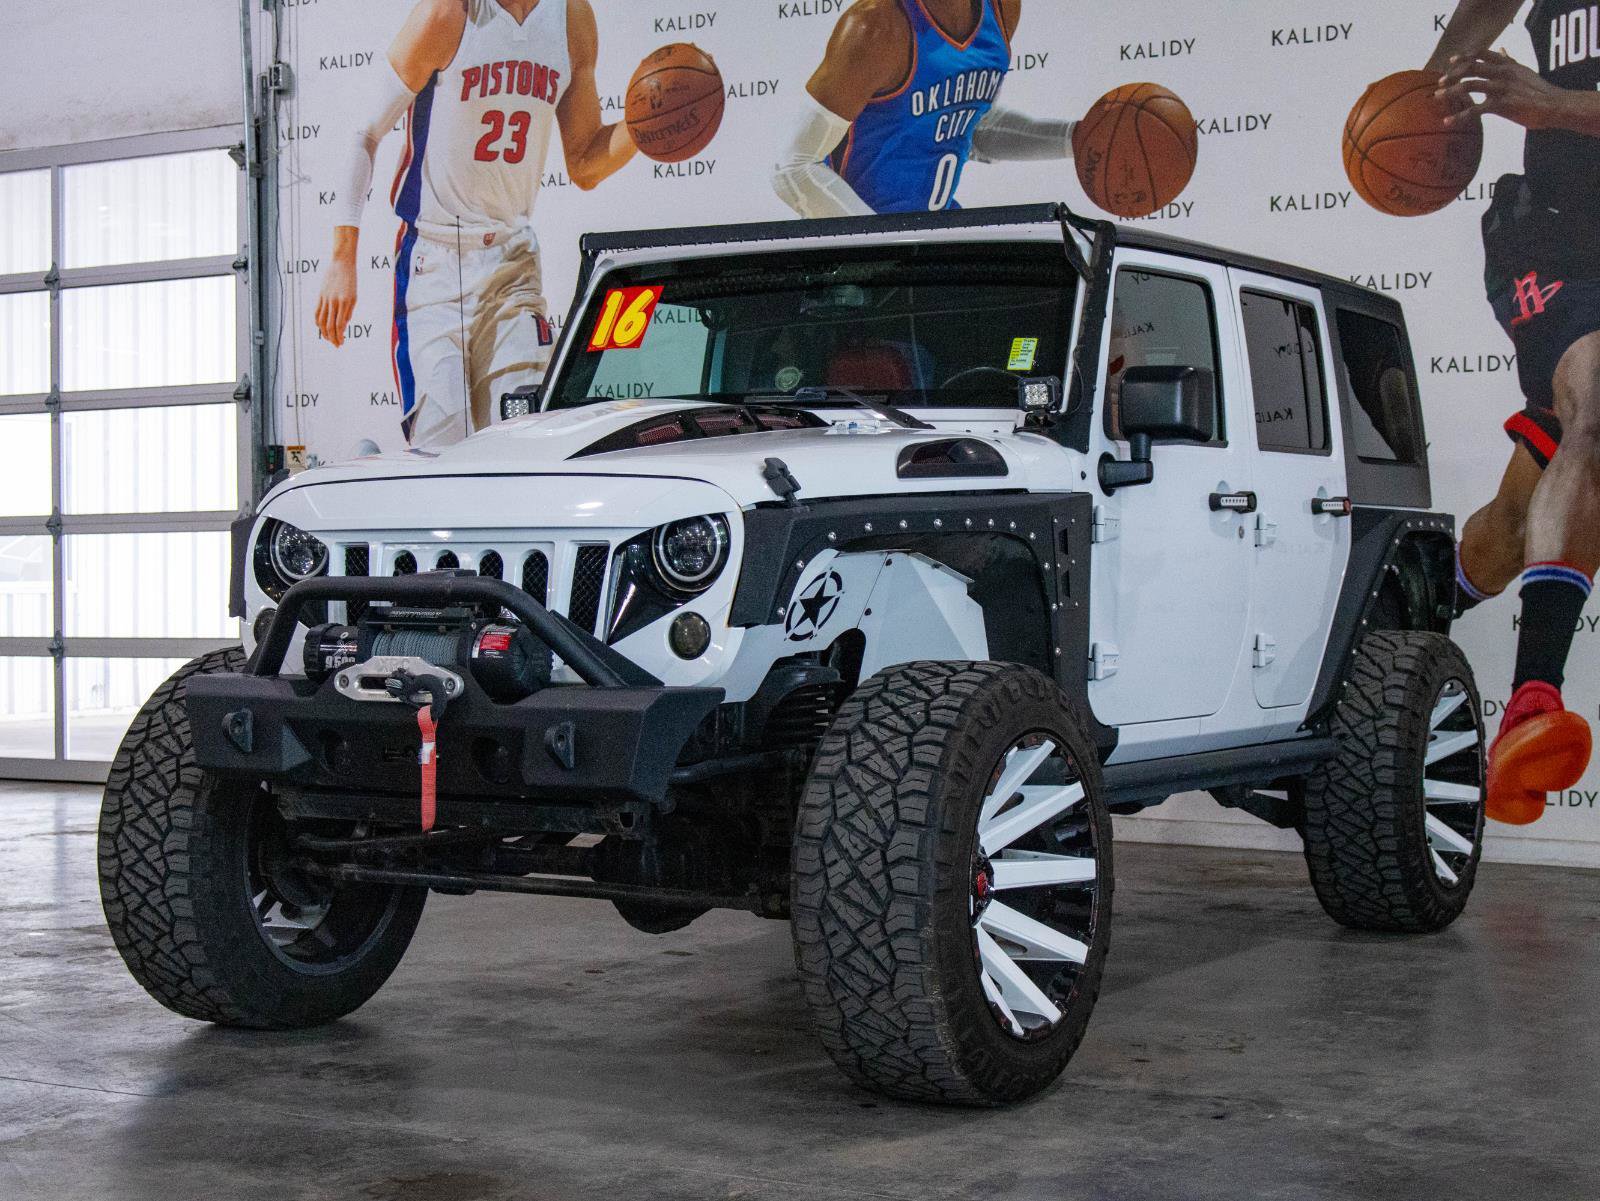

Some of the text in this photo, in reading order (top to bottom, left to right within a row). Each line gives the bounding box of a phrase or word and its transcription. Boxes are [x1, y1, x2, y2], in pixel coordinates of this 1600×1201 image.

[779, 0, 843, 19] KALIDY
[654, 12, 717, 32] KALIDY
[1272, 23, 1353, 46] KALIDY
[1120, 38, 1196, 60] KALIDY
[320, 52, 374, 70] KALIDY
[461, 60, 560, 105] PISTONS
[727, 80, 779, 98] ALIDY
[912, 70, 1001, 116] OKLAHOM
[935, 109, 976, 142] CITY
[1195, 114, 1272, 135] KALIDY
[474, 109, 531, 164] 23
[654, 160, 716, 179] KALIDY
[1270, 192, 1351, 213] KALIDY
[1351, 272, 1433, 291] KALIDY
[591, 288, 656, 348] 16
[1431, 355, 1516, 373] KALIDY
[595, 382, 654, 399] KALIDY
